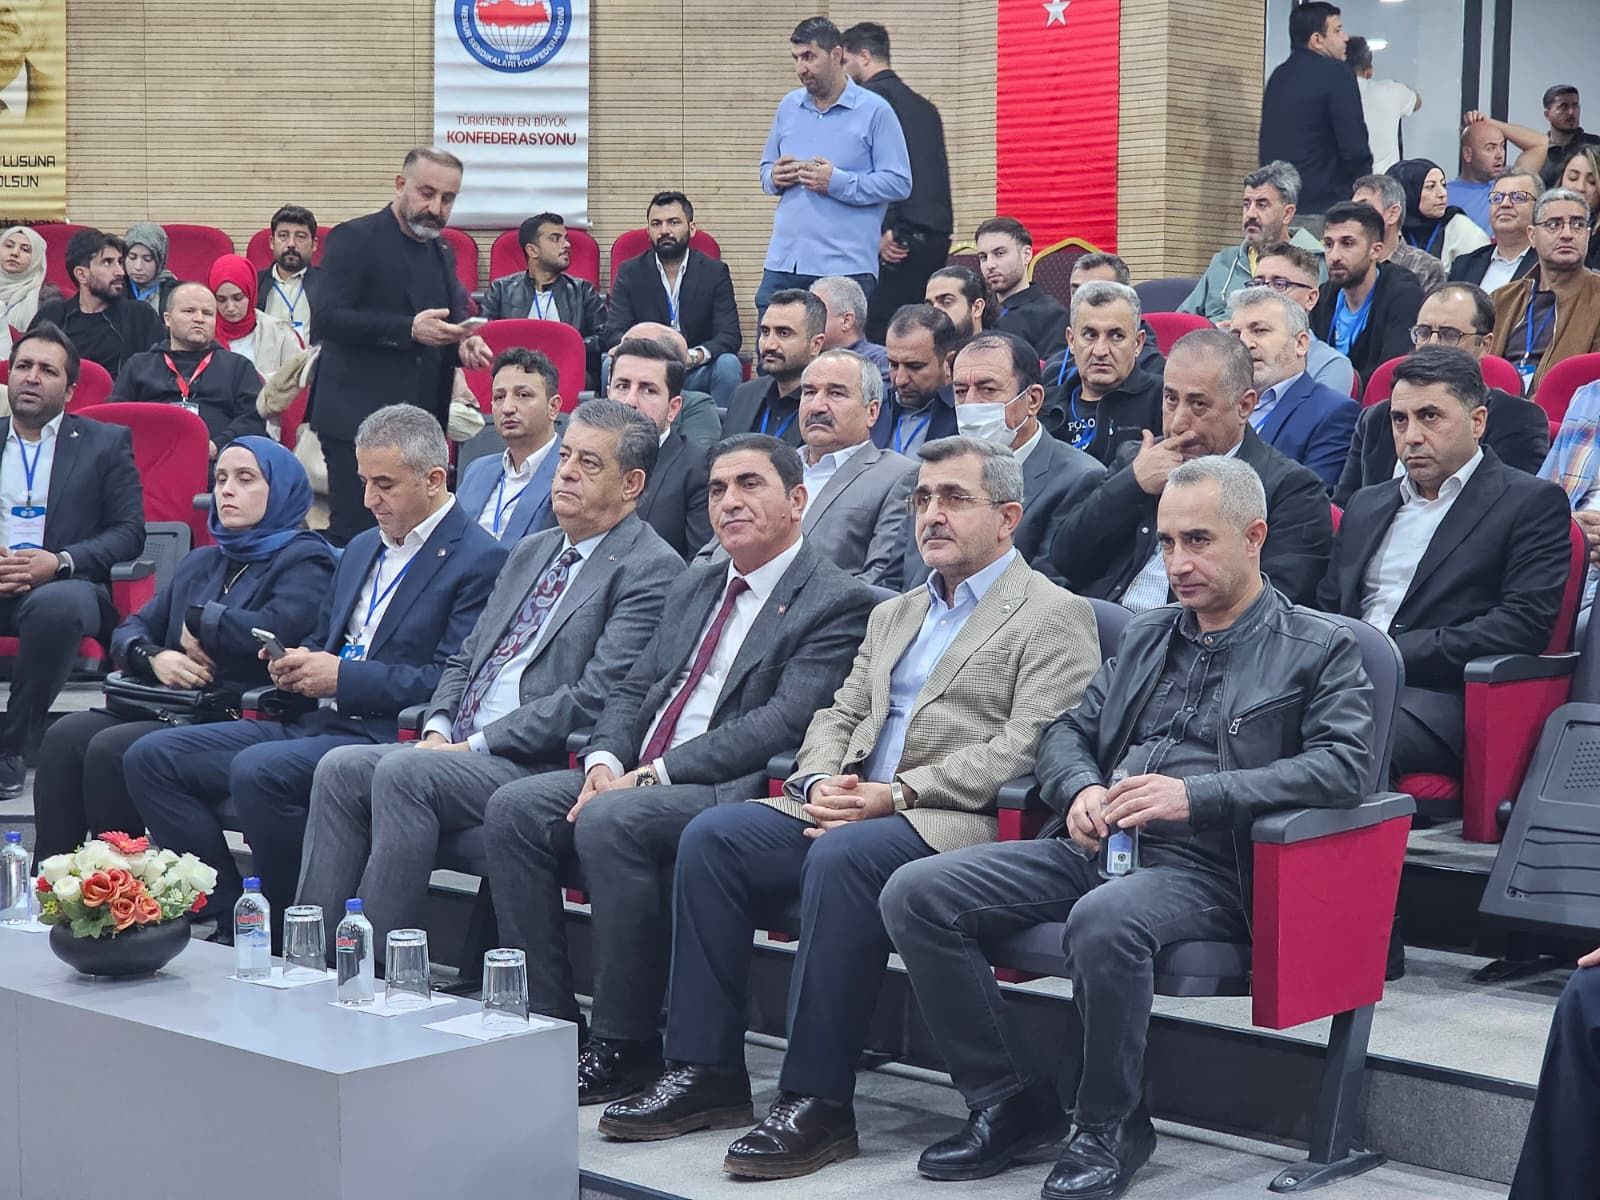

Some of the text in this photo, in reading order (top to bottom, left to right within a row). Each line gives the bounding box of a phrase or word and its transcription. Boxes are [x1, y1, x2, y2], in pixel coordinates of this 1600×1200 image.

[517, 116, 531, 127] EN
[534, 114, 567, 128] BÜYÜK
[447, 130, 577, 146] KONFEDERASYONU
[0, 155, 56, 168] LUSUNA
